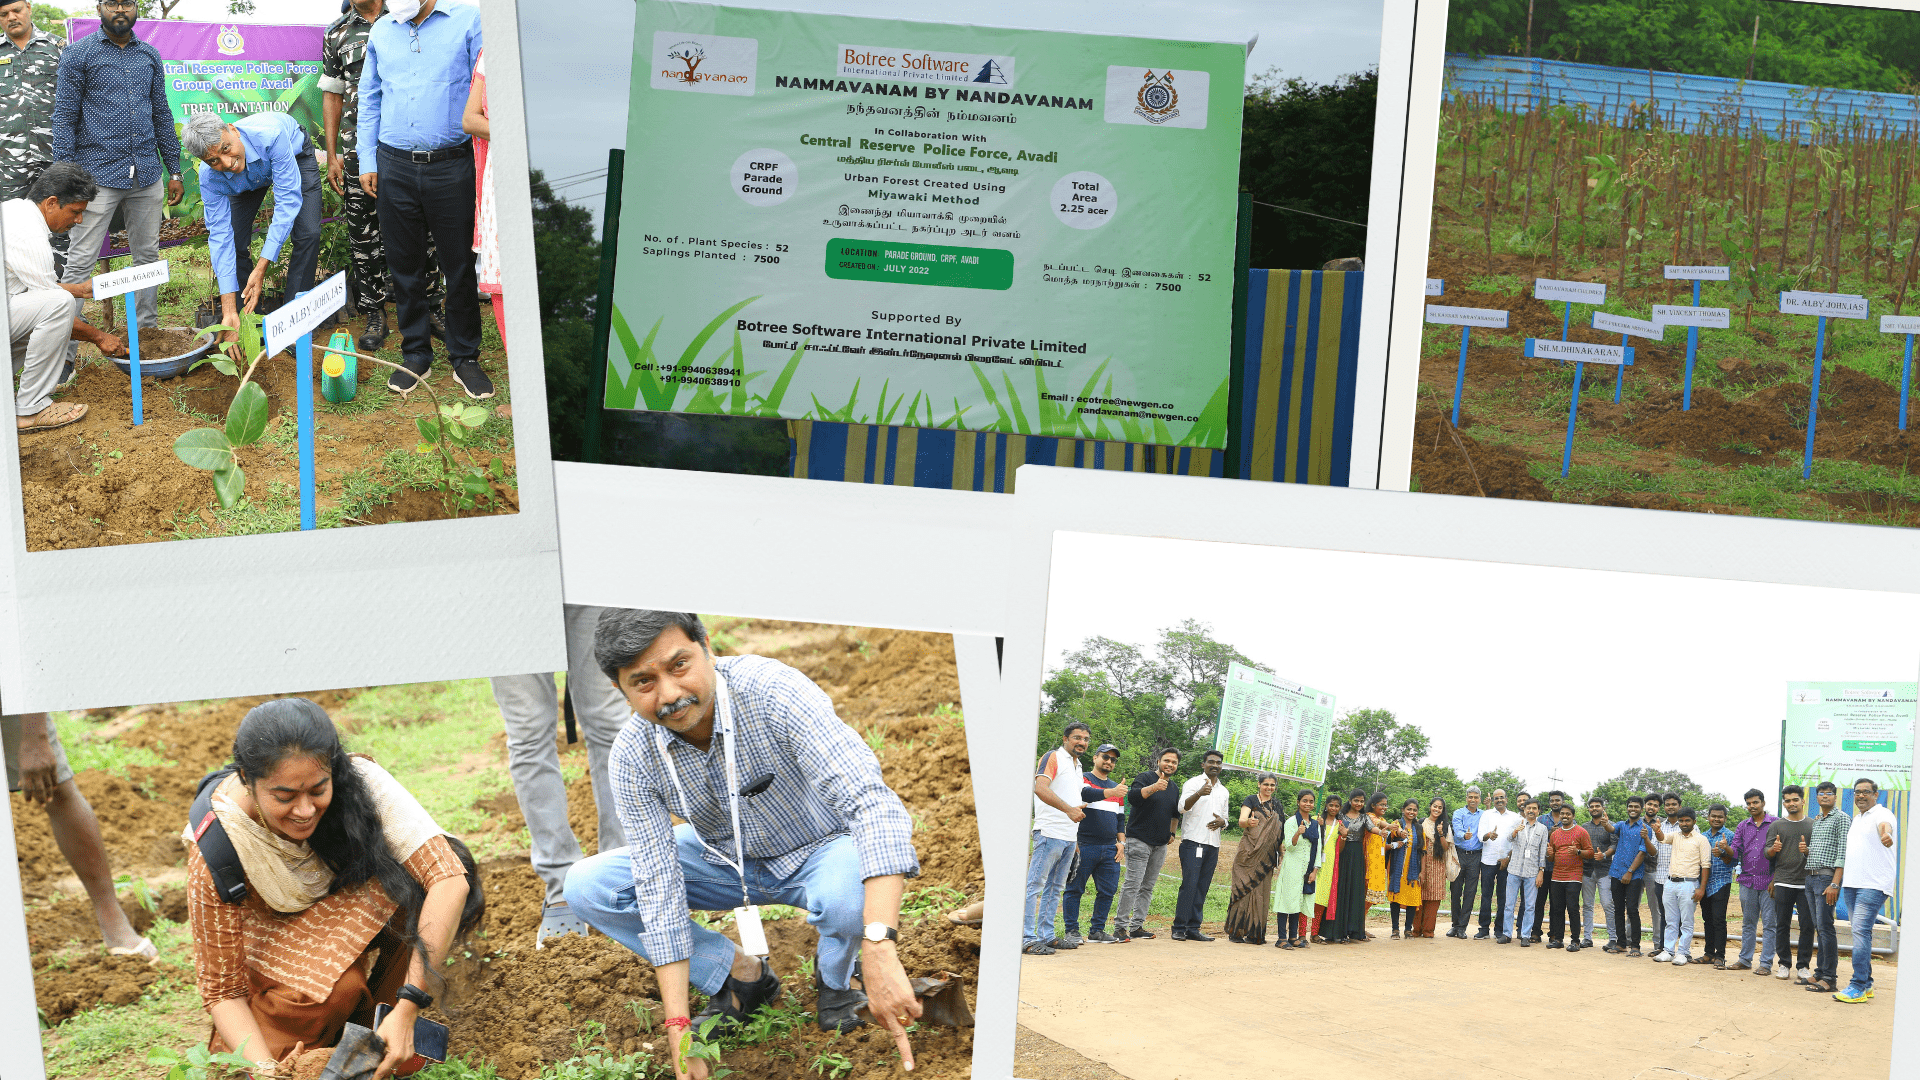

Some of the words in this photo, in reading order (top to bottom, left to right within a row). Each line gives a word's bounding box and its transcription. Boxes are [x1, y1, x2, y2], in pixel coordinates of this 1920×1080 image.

[845, 49, 895, 67] Botree
[902, 53, 968, 72] Software
[165, 63, 188, 74] tral
[192, 64, 243, 74] Reserve
[247, 63, 283, 74] Police
[286, 63, 318, 74] Force
[844, 67, 900, 77] International
[904, 71, 933, 80] Private
[936, 73, 969, 82] Limited
[662, 69, 747, 84] nandavanam
[173, 79, 212, 92] Group
[216, 79, 257, 90] Centre
[261, 78, 293, 89] Avadi
[776, 76, 917, 98] NAMMAVANAM
[925, 87, 949, 100] BY
[956, 89, 1093, 110] NANDAVANAM
[182, 103, 214, 115] TREE
[217, 101, 289, 113] PLANTATION
[847, 102, 940, 120] நந்தவனத்தின்
[947, 110, 1017, 124] நம்மவனம்
[888, 129, 958, 140] Collaboration
[962, 134, 986, 142] With
[800, 134, 851, 148] Central
[860, 138, 915, 153] Reserve
[924, 143, 965, 156] Police
[970, 147, 1012, 161] Force,
[1017, 150, 1058, 163] Avadi
[750, 162, 778, 171] CRPF
[744, 173, 782, 183] Parade
[845, 173, 878, 183] Urban
[883, 176, 919, 186] Forest
[924, 179, 968, 189] Created
[974, 183, 1006, 193] Using
[742, 184, 782, 195] Ground
[1072, 182, 1099, 191] Total
[868, 190, 927, 202] Miyawaki
[932, 194, 980, 205] Method
[1072, 193, 1097, 202] Area
[1060, 204, 1084, 213] 2.25
[992, 230, 1021, 238] வனம்
[644, 234, 661, 242] No.
[667, 236, 678, 244] of
[688, 237, 717, 246] Plant
[721, 239, 762, 250] Species
[776, 244, 789, 252] 52
[642, 246, 690, 258] Saplings
[694, 250, 736, 260] Planted
[754, 255, 780, 264] 7500
[885, 250, 909, 260] PARADE
[911, 251, 938, 263] GROUND,
[940, 254, 958, 265] CRPF,
[960, 255, 979, 265] AVADI
[839, 262, 866, 270] CREATED
[883, 264, 906, 273] JULY
[909, 266, 929, 274] 2022
[132, 269, 164, 282] AGARWAL
[1198, 274, 1211, 282] 52
[1155, 283, 1182, 292] 7500
[1786, 298, 1799, 306] DR.
[1802, 299, 1825, 307] ALBY
[272, 321, 286, 338] DR.
[289, 301, 312, 328] ALBY
[872, 310, 940, 324] Supported
[946, 315, 962, 327] By
[737, 320, 788, 333] Botree
[792, 323, 861, 338] Software
[866, 328, 966, 346] International
[972, 335, 1025, 350] Private
[1031, 339, 1087, 354] Limited
[634, 363, 653, 371] Cell
[660, 375, 741, 387] +91-9940638910
[1041, 393, 1068, 402] Email
[1076, 396, 1174, 410] ecotree@newgen.co
[1077, 407, 1199, 423] nandavanam@newgen.co
